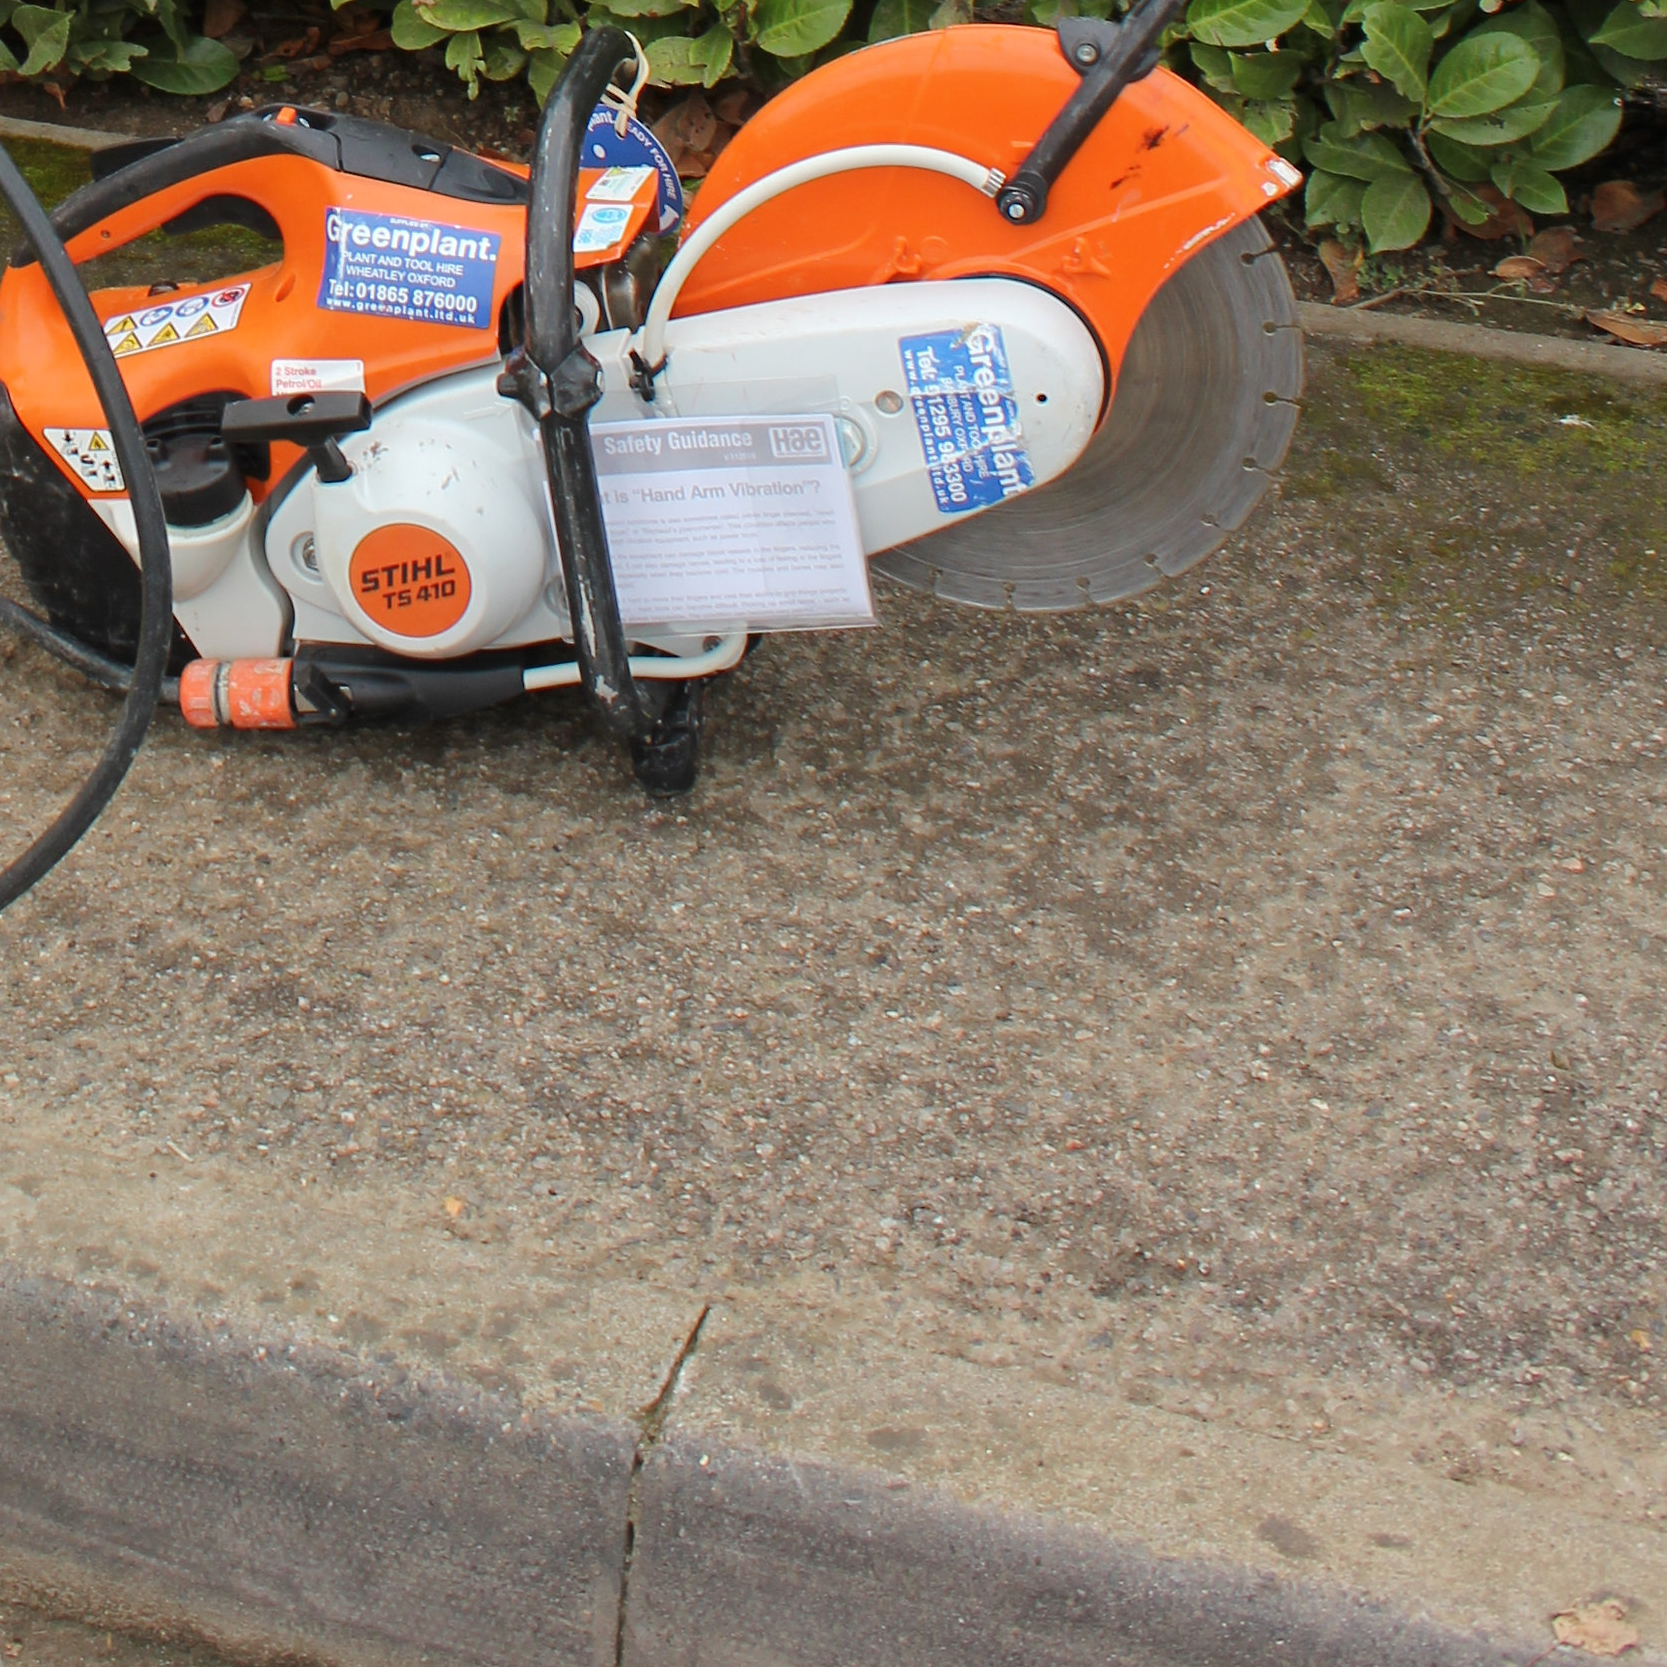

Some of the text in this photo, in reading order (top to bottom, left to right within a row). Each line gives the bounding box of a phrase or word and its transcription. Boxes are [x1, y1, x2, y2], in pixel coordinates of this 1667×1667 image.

[650, 147, 668, 172] FOR
[326, 213, 497, 261] Greenplant.
[343, 250, 465, 276] PLANT AND TOOL HIRE
[346, 264, 456, 289] WHEATLEY OXFORD
[412, 288, 478, 313] 876000
[276, 366, 317, 376] 2 Stroke
[961, 400, 977, 423] AND
[603, 430, 753, 455] Safety Guidance
[691, 484, 725, 500] Arm
[361, 554, 455, 593] STIHL
[382, 579, 456, 610] TS 410
